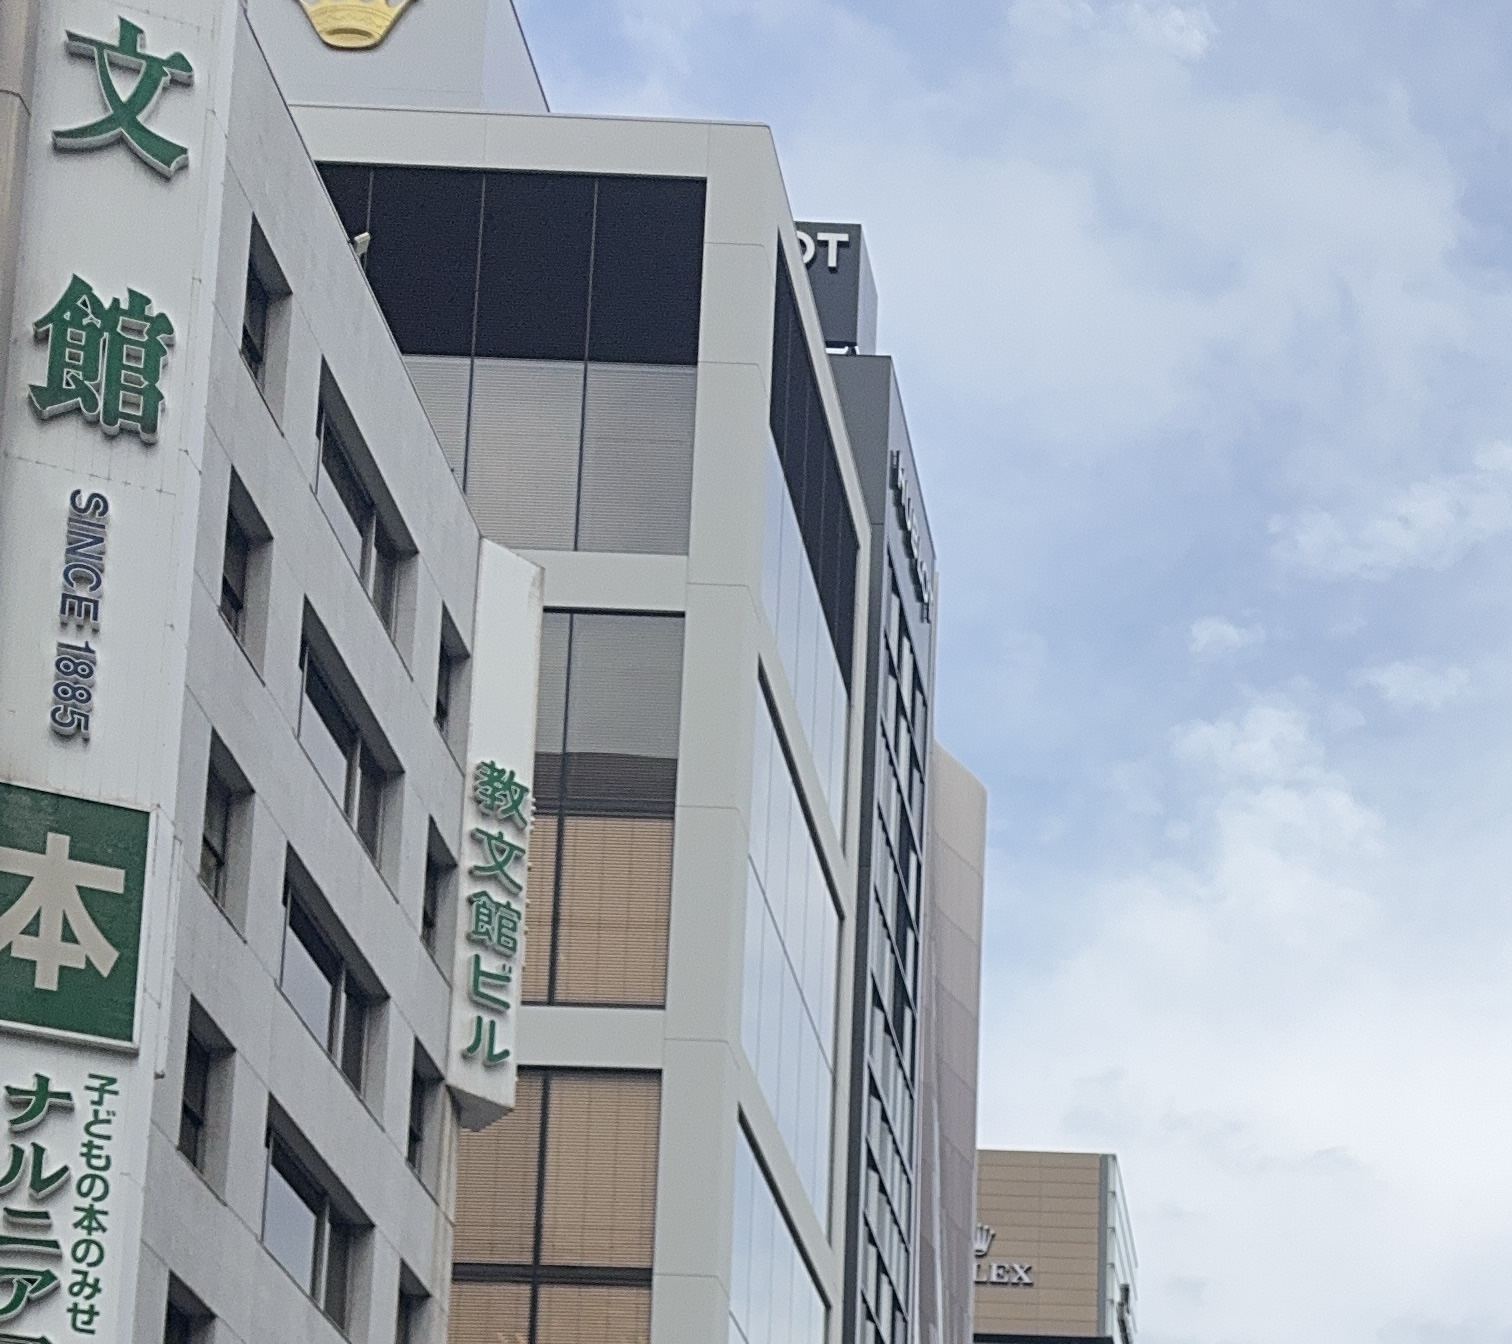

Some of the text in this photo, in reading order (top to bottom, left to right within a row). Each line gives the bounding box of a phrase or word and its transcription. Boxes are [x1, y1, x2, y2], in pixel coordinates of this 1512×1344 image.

[50, 488, 110, 745] SINCE 1885
[0, 832, 126, 992] 本
[464, 760, 530, 1066] 教文館ビル
[66, 1072, 120, 1336] 子どもの本のみせ
